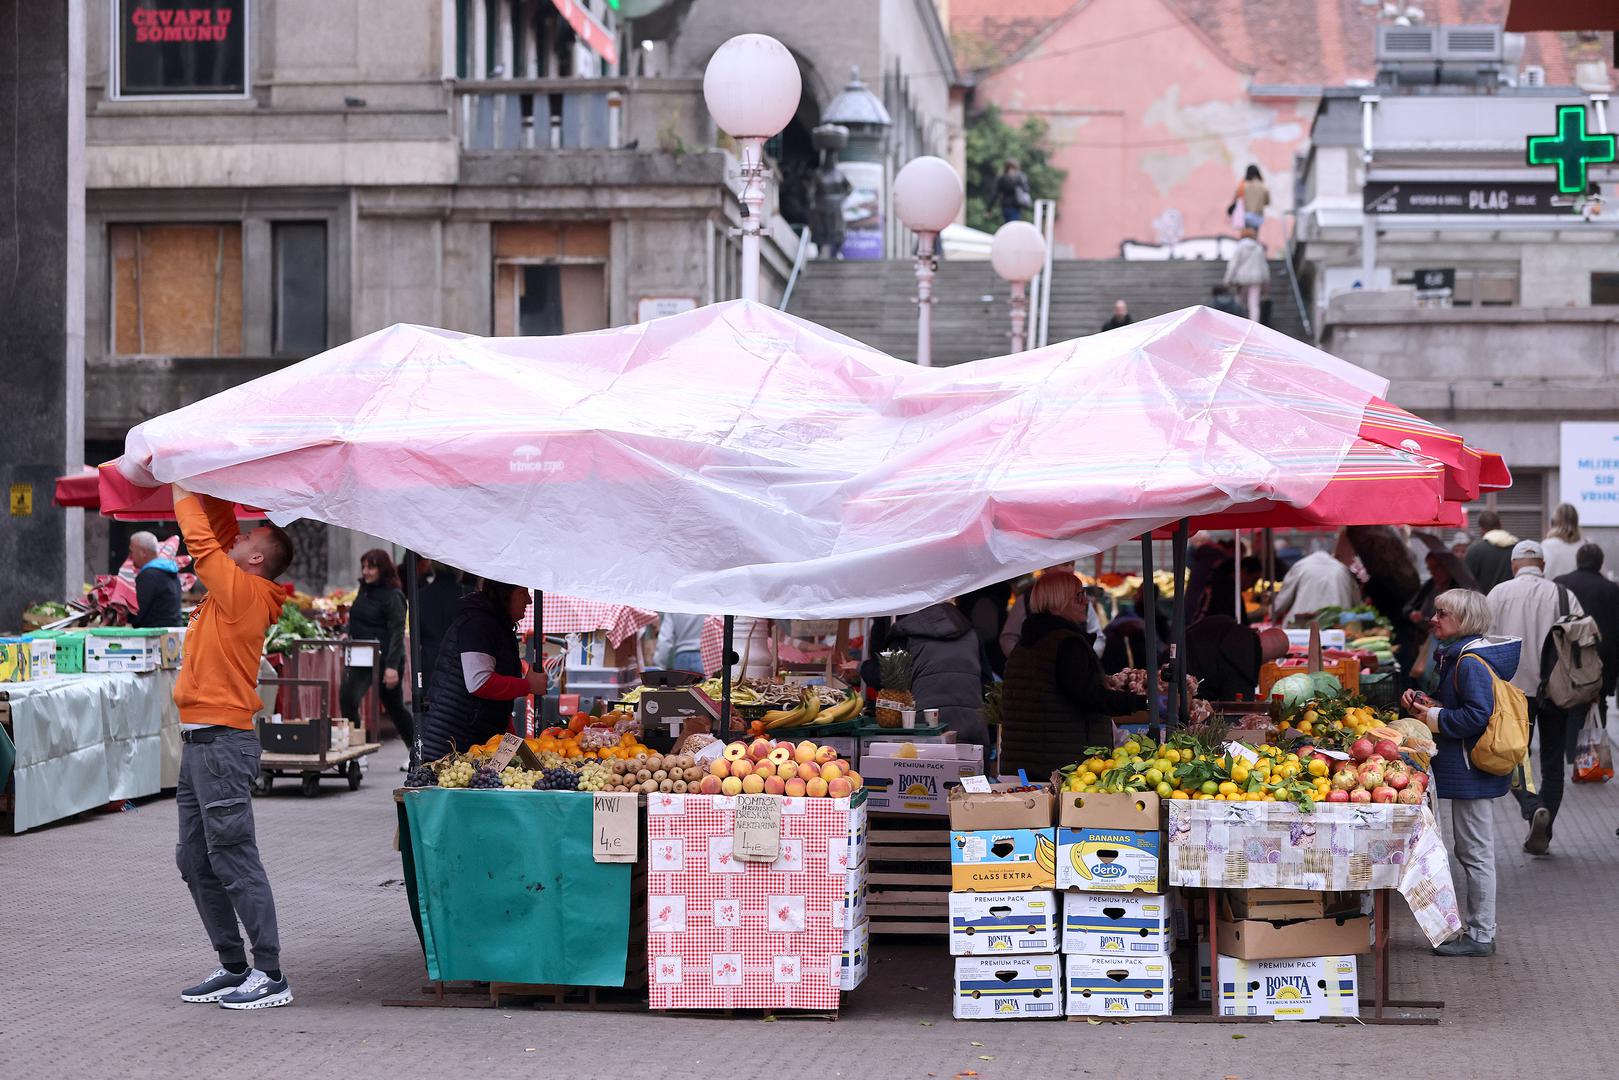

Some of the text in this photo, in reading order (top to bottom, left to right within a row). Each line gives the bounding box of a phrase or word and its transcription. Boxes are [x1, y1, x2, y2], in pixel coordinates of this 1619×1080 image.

[132, 7, 232, 26] ČEVAPI U
[136, 26, 227, 42] SOMUNU
[1594, 474, 1615, 486] SIR
[893, 761, 926, 769] PREMIUM
[898, 774, 938, 794] BONITA
[595, 796, 620, 812] KIWI
[1089, 834, 1131, 843] BANANAS
[1003, 872, 1032, 880] EXTRA
[1092, 863, 1125, 878] derby
[988, 935, 1013, 947] BONITA
[1100, 935, 1125, 948] BONITA
[1265, 975, 1311, 997] BONITA
[994, 998, 1019, 1010] BONITA
[1104, 997, 1129, 1009] BONITA
